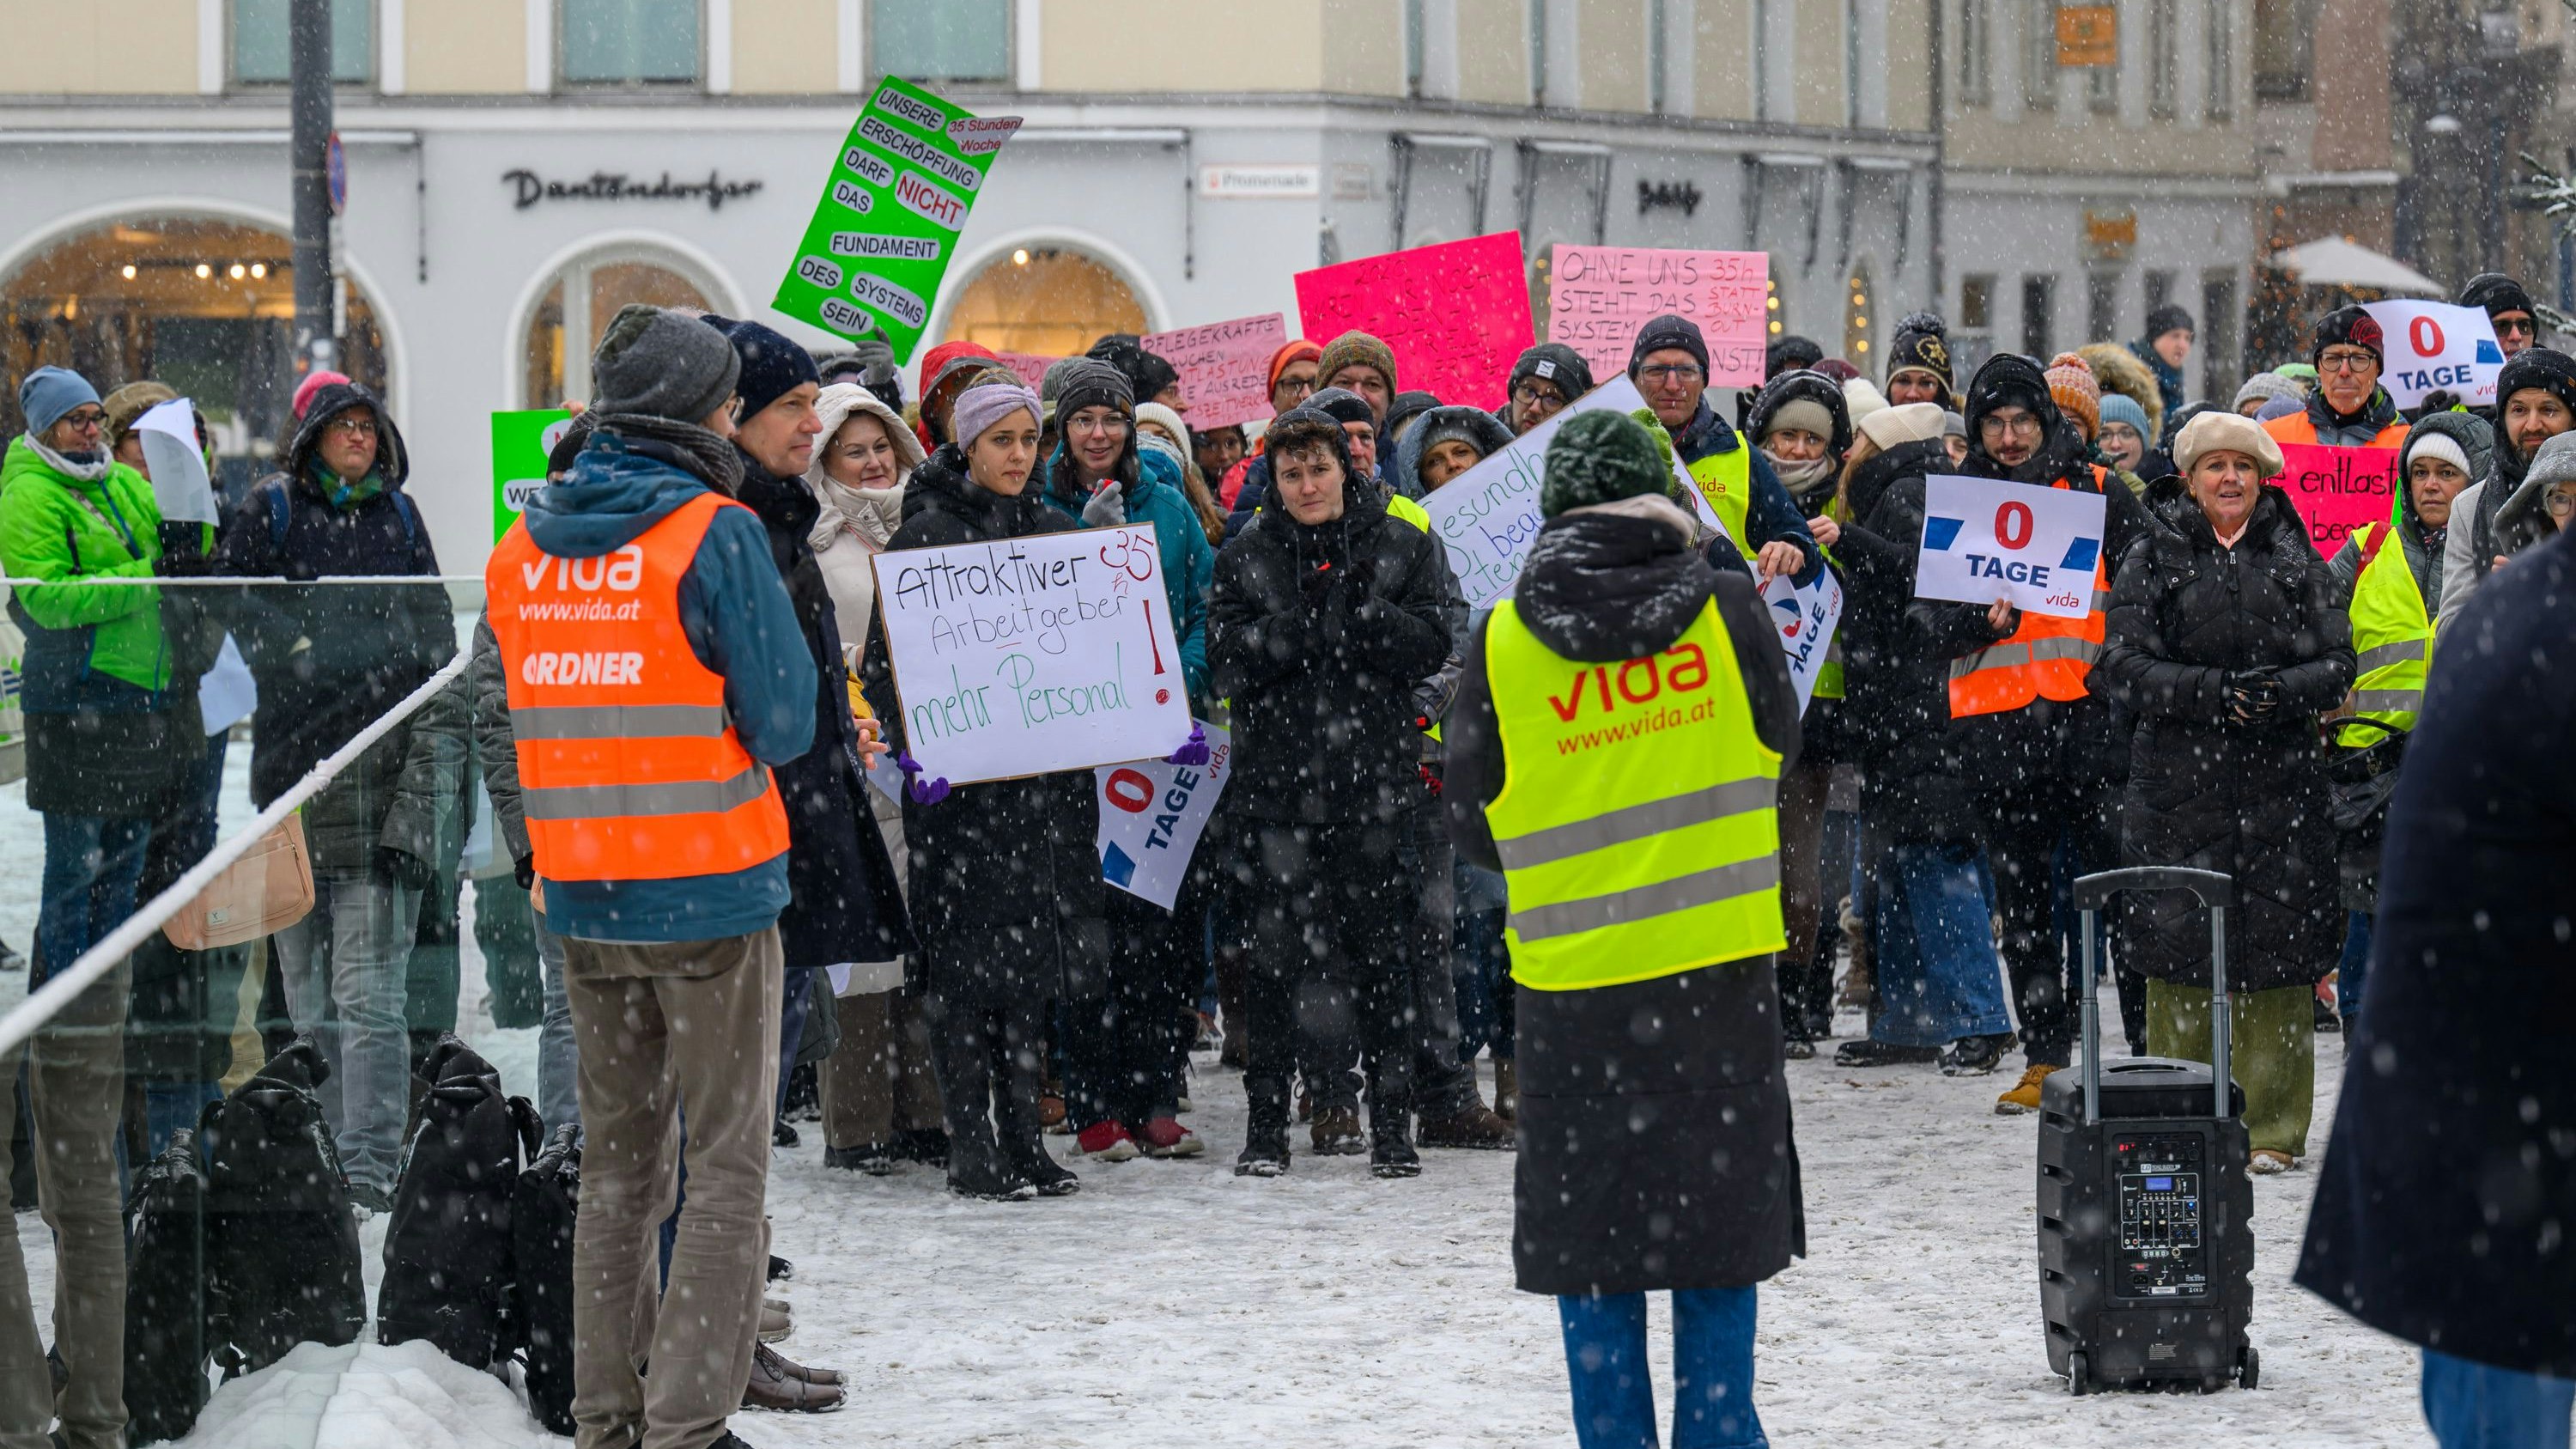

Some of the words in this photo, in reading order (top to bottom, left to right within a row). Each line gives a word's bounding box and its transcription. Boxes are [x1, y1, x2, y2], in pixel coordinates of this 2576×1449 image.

[878, 89, 942, 129] UNSERE
[948, 120, 964, 132] 35
[860, 119, 975, 187] ERSCHÖPFUNG
[960, 139, 1001, 152] Woche
[846, 150, 890, 182] DARF
[836, 184, 870, 212] DAS
[896, 175, 963, 224] NICHT
[832, 234, 936, 259] FUNDAMENT
[799, 259, 839, 287] DES
[1561, 252, 1635, 284] OHNE
[1647, 258, 1699, 285] UNS
[1709, 258, 1754, 282] 35h
[854, 277, 923, 324] SYSTEMS
[1558, 289, 1637, 314] STEHT
[1646, 293, 1697, 314] DAS
[1708, 286, 1761, 299] STATT
[823, 301, 867, 331] SEIN
[1557, 319, 1637, 341] SYSTEM
[1710, 320, 1746, 333] OUT
[2409, 315, 2445, 358] 0
[1711, 348, 1765, 373] NST!
[2397, 364, 2473, 391] TAGE
[2476, 381, 2497, 396] vid
[1995, 501, 2033, 550] 0
[896, 541, 1087, 609] Attraktiver
[1100, 530, 1154, 581] 35
[1965, 554, 2050, 588] TAGE
[519, 598, 641, 621] www.vida.at
[2045, 592, 2080, 608] vida
[933, 589, 1128, 654] Arbeitgeber
[1792, 601, 1826, 674] TAGE
[912, 664, 992, 745] mehr
[996, 642, 1133, 728] Personal
[1557, 696, 1716, 756] www.vida.at
[1209, 743, 1230, 779] vida
[1145, 766, 1200, 849] TAGE
